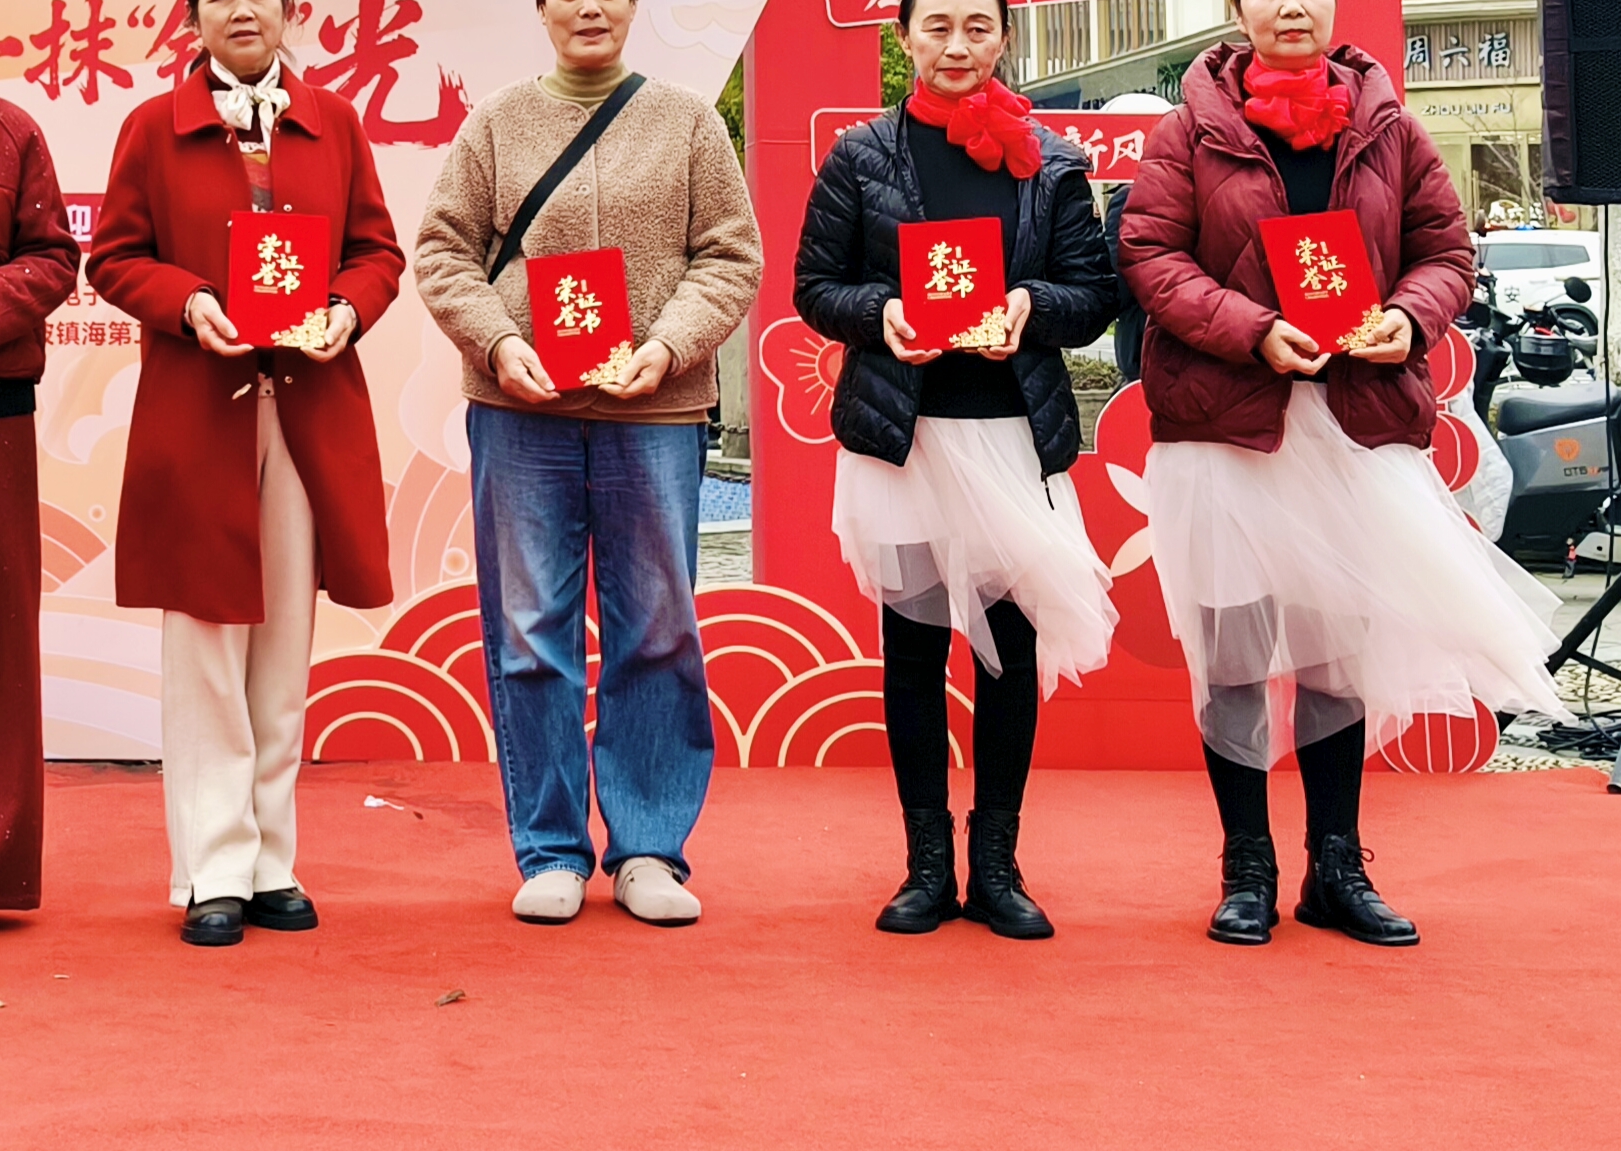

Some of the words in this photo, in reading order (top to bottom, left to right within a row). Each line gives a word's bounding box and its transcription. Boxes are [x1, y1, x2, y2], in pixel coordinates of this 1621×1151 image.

[1404, 31, 1511, 70] 周六福
[1421, 104, 1462, 116] ZHOU
[1465, 103, 1488, 115] LIU
[1491, 102, 1512, 114] FU
